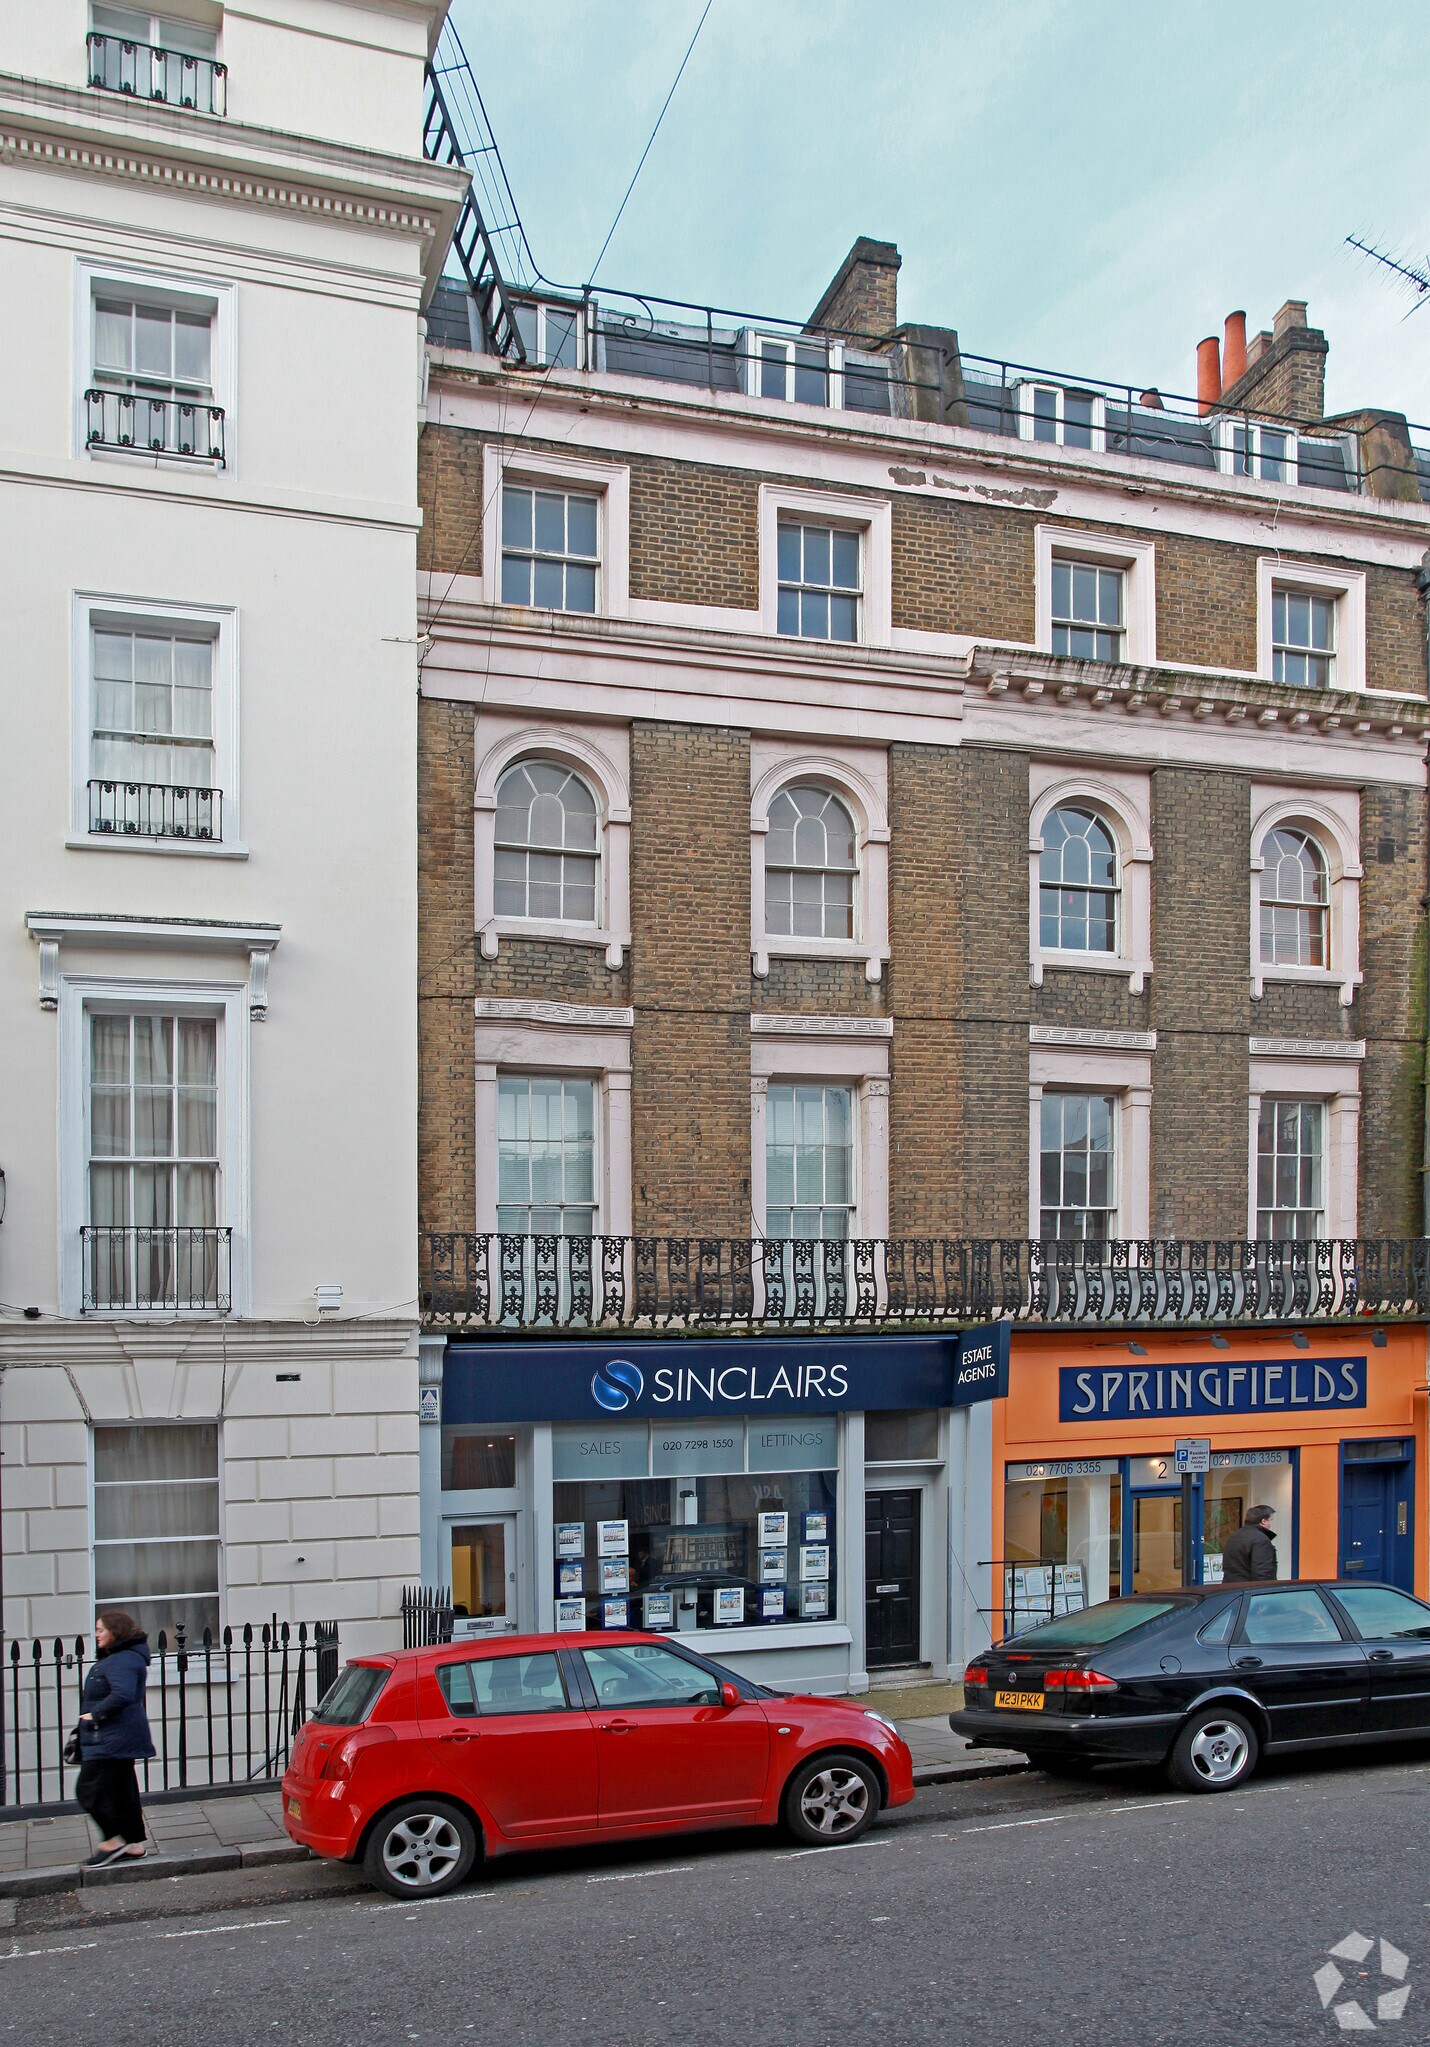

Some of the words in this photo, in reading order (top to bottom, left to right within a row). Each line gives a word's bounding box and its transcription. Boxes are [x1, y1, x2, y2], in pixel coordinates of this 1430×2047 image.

[962, 1345, 992, 1365] ESTATE
[958, 1363, 996, 1384] AGENTS
[652, 1364, 848, 1402] SINCLAIRS
[1072, 1363, 1358, 1414] SPRINGFIELDS
[580, 1441, 621, 1456] SALES
[662, 1441, 682, 1451] 020
[684, 1440, 708, 1450] 7298
[712, 1438, 734, 1448] 1550
[761, 1432, 823, 1448] LETTINGS
[1212, 1454, 1230, 1466] 020
[1234, 1453, 1256, 1464] 7706
[1259, 1452, 1282, 1463] 3355
[1026, 1465, 1045, 1476] 020
[1048, 1463, 1073, 1475] 7706
[1076, 1462, 1101, 1474] 3355
[1157, 1461, 1167, 1479] 2
